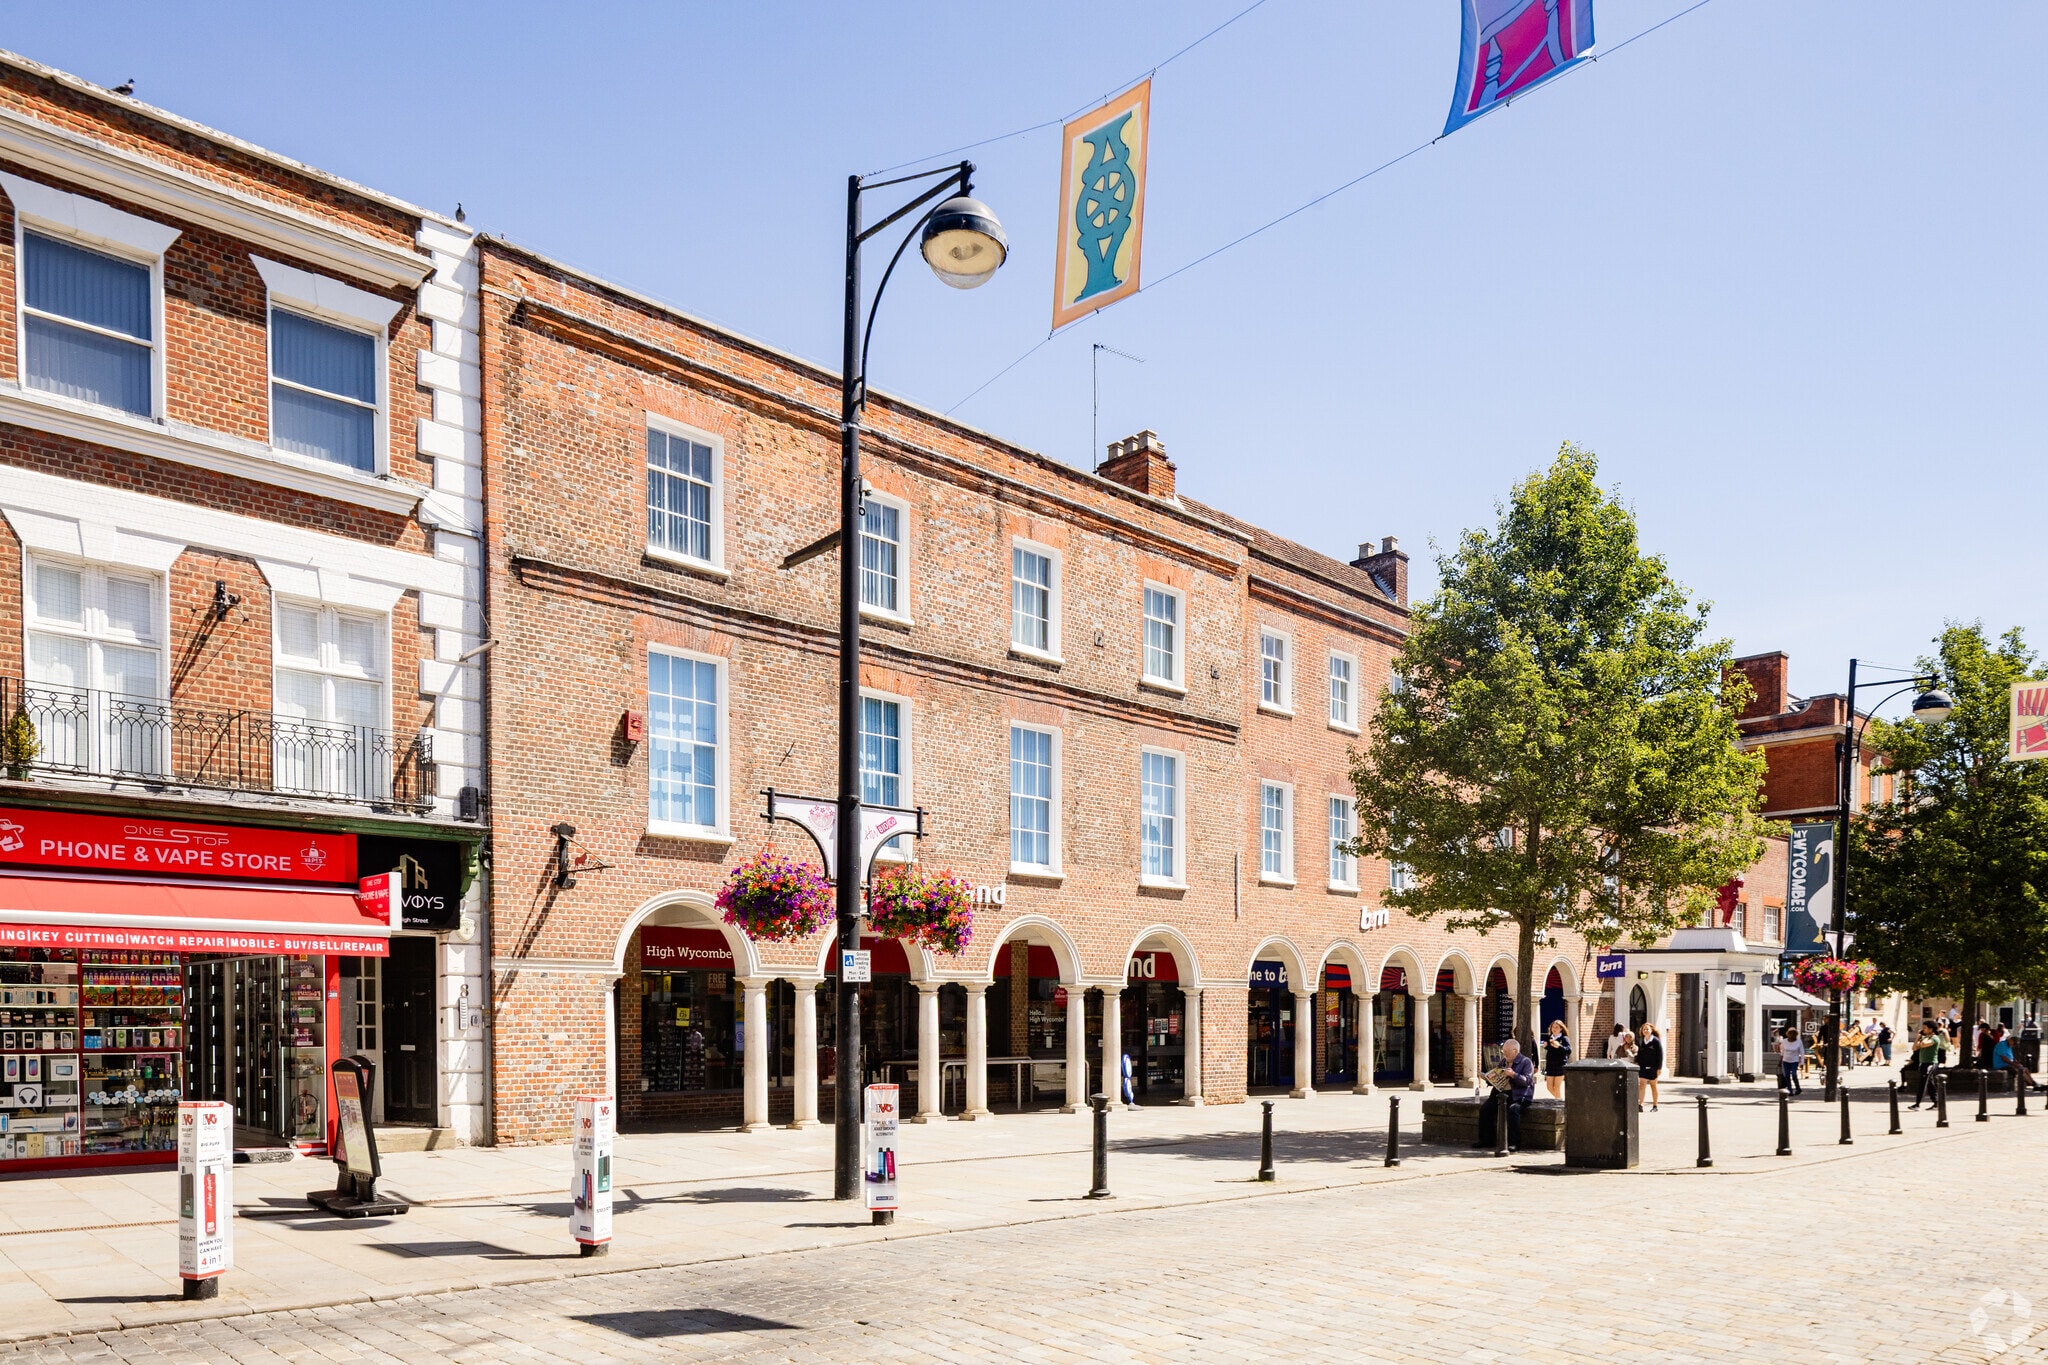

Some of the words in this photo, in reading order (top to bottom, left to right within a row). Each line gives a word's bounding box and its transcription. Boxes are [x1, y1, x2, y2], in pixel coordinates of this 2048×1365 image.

[123, 825, 165, 837] ONE
[170, 829, 229, 846] STOP
[1793, 829, 1808, 839] MY
[40, 839, 126, 861] PHONE
[133, 846, 149, 862] &
[155, 847, 213, 867] VAPE
[220, 852, 292, 871] STORE
[1791, 838, 1808, 906] WYCOMBE
[285, 940, 383, 952] BUY/SELL/REPAIR
[646, 946, 675, 959] High
[677, 947, 732, 960] Wycombe
[1763, 958, 1780, 975] RKS
[708, 973, 726, 983] FREE
[1264, 969, 1276, 981] to
[1029, 1016, 1041, 1024] High
[201, 1257, 207, 1265] 4
[209, 1256, 216, 1264] in
